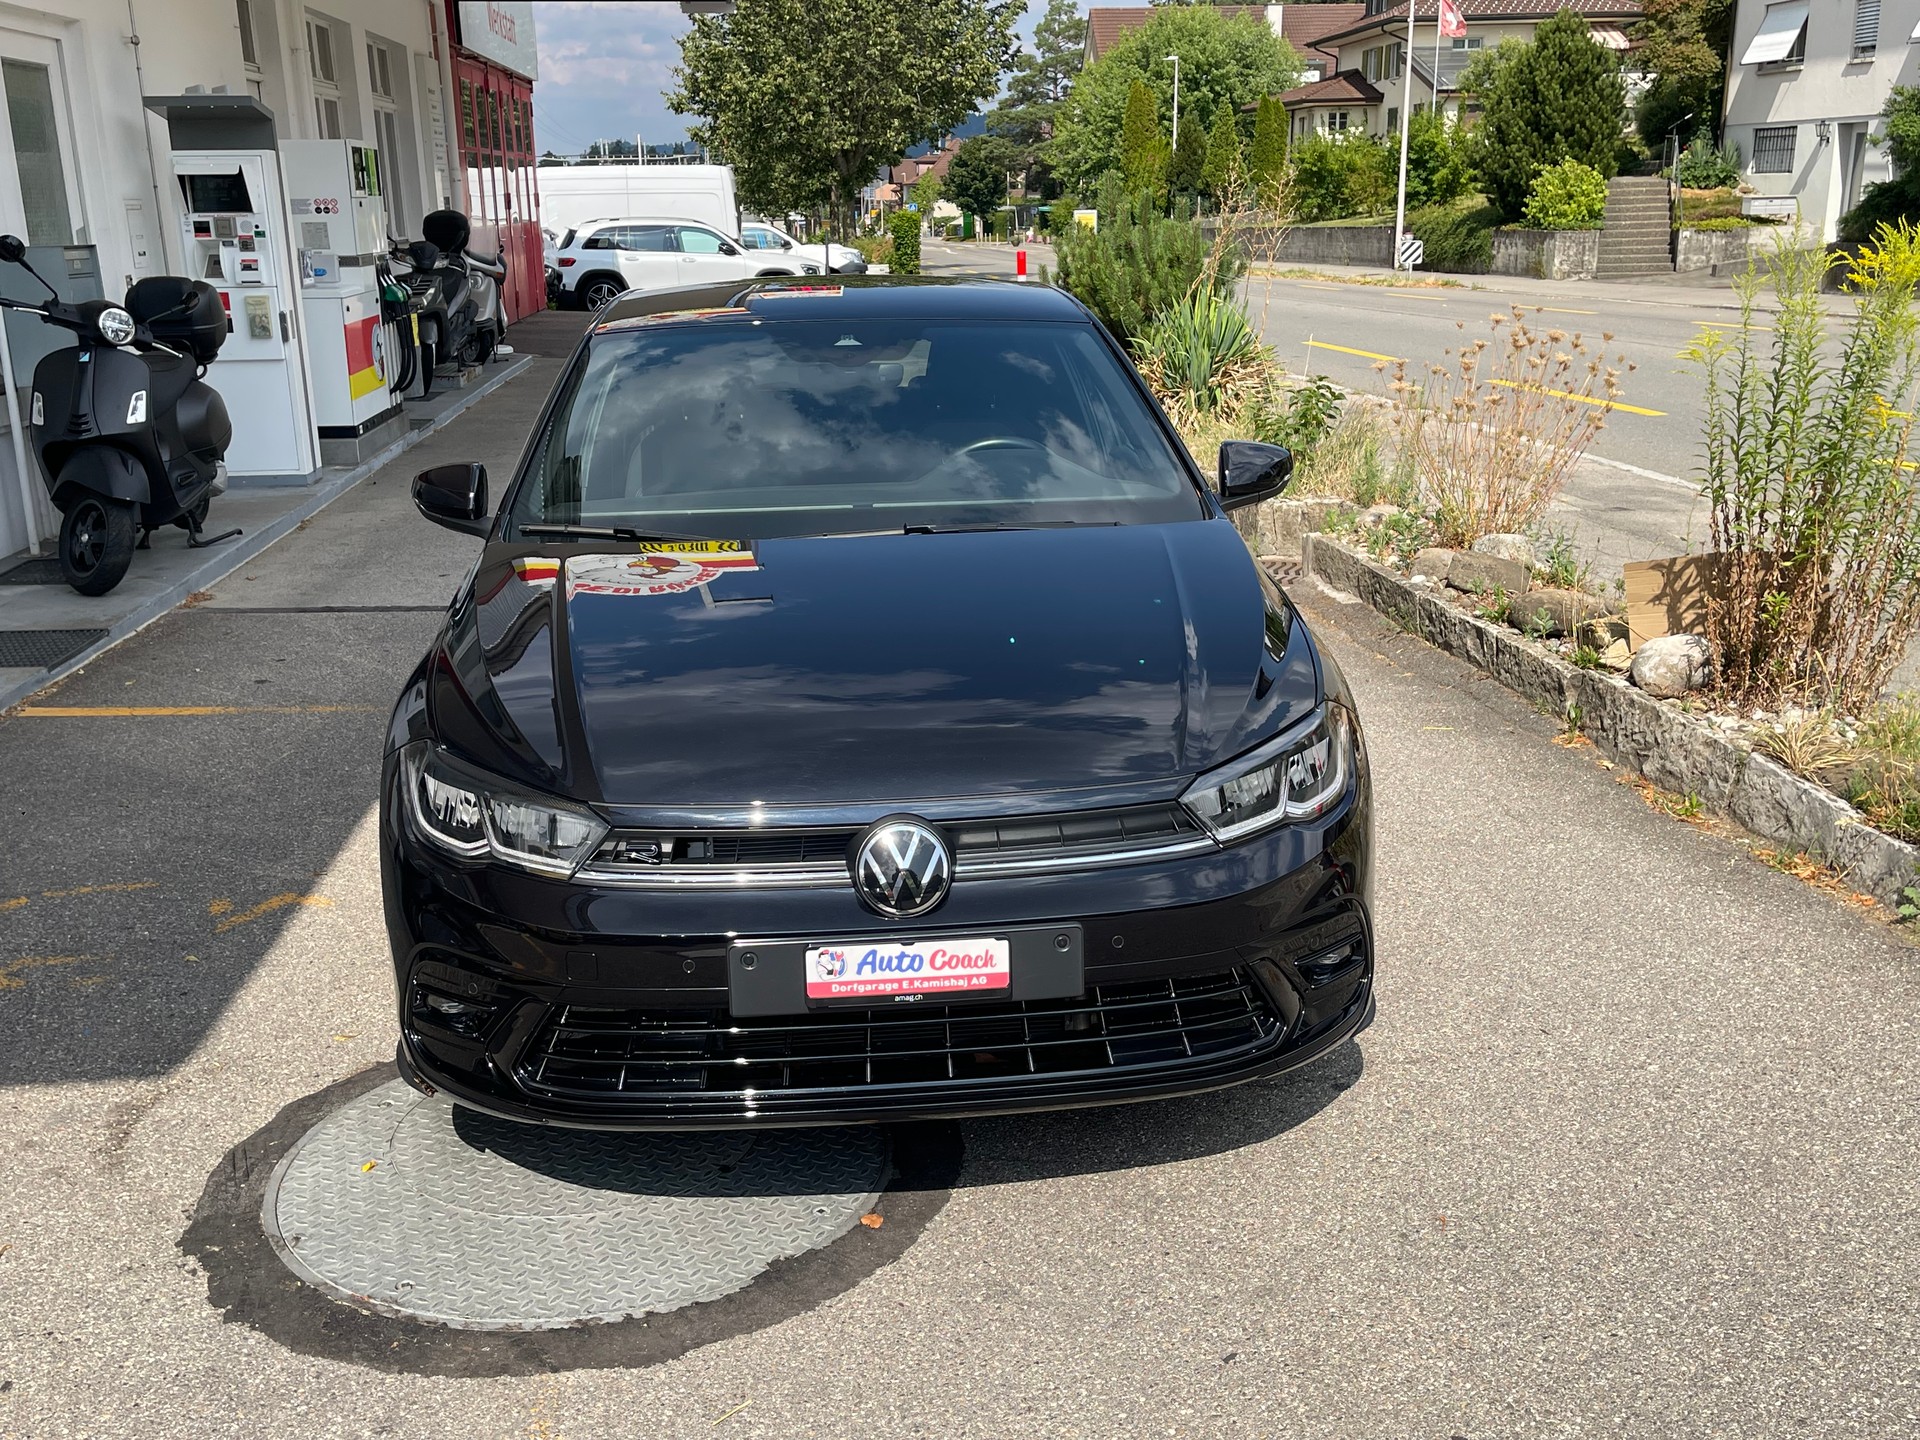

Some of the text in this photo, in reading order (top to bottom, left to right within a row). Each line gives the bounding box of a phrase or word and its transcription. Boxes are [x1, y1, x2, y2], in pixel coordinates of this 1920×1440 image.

[486, 2, 517, 46] Werkstatt
[856, 949, 997, 975] Auto Coach
[831, 976, 988, 993] Dorfgarage E.Kamishaj AG
[894, 993, 924, 1002] amag.ch
